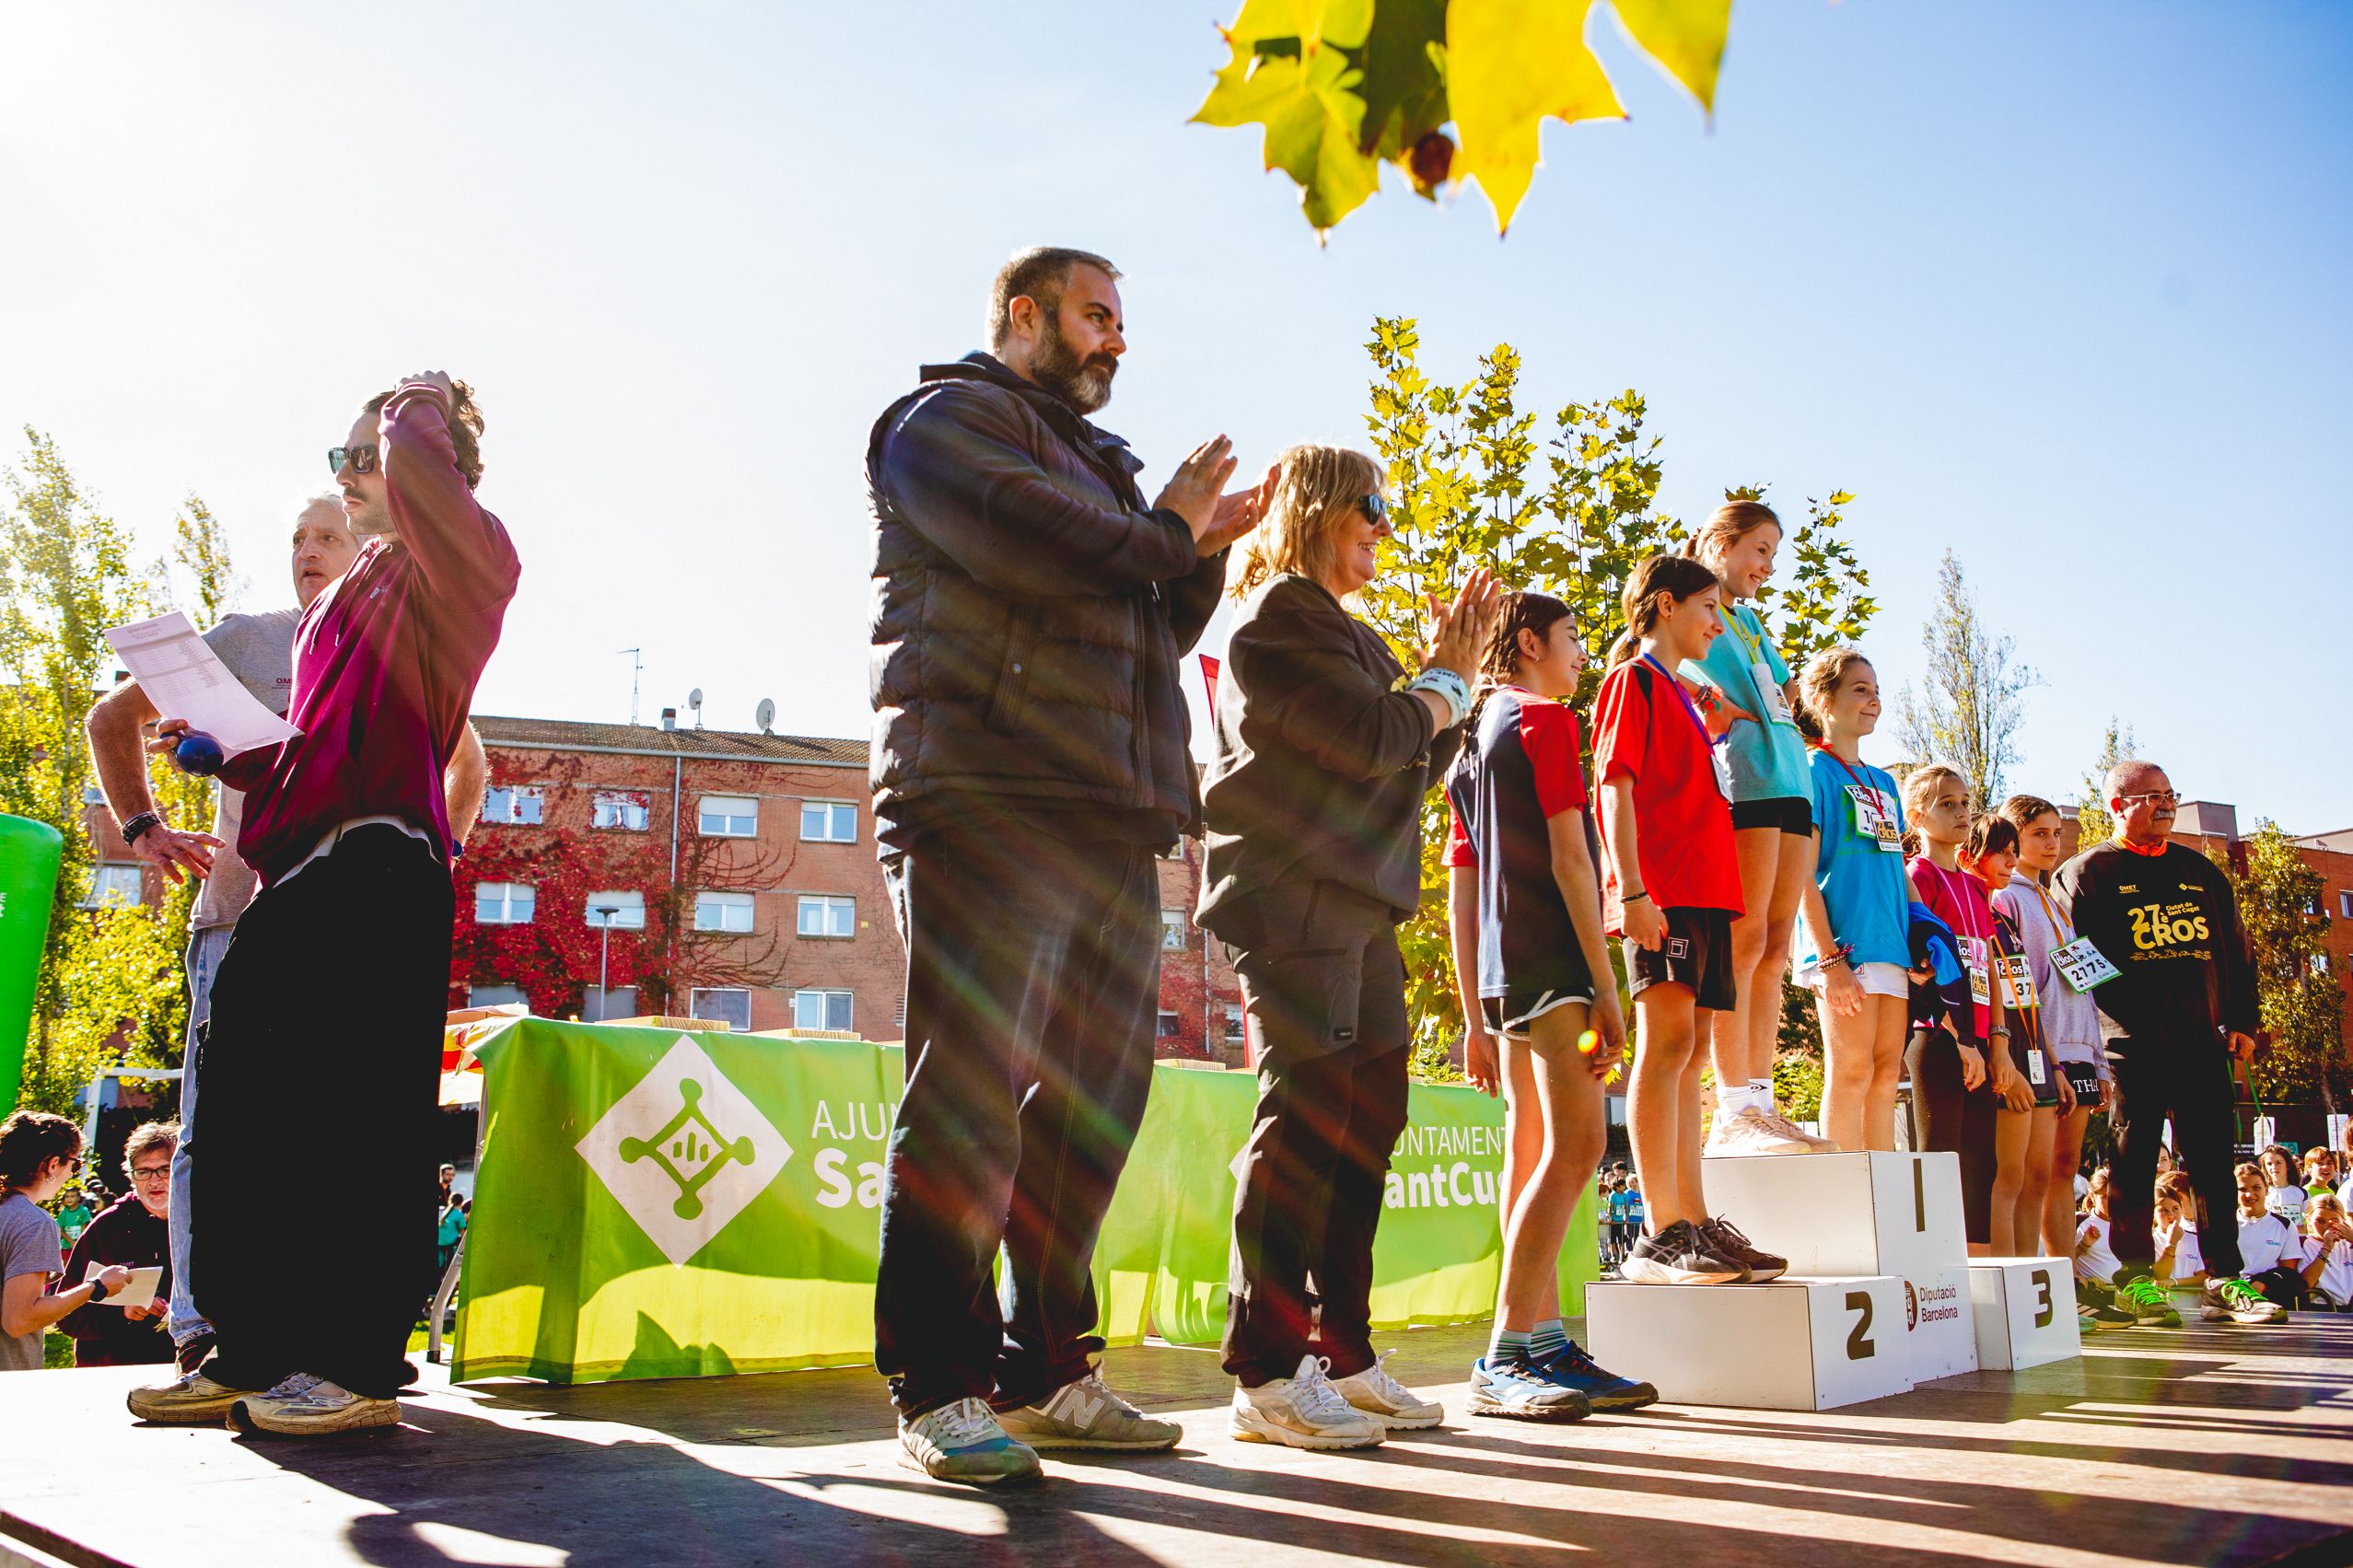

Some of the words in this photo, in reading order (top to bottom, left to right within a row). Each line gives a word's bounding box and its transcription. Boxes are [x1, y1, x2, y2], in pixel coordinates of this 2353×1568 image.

[2133, 916, 2209, 949] CROS
[2071, 958, 2106, 981] 2775
[1392, 1126, 1506, 1156] UNTAMEN
[1384, 1161, 1504, 1209] antCu
[1919, 1283, 1956, 1305] Diputació
[2032, 1269, 2054, 1329] 3
[1846, 1291, 1875, 1360] 2
[1921, 1305, 1959, 1323] Barcelona
